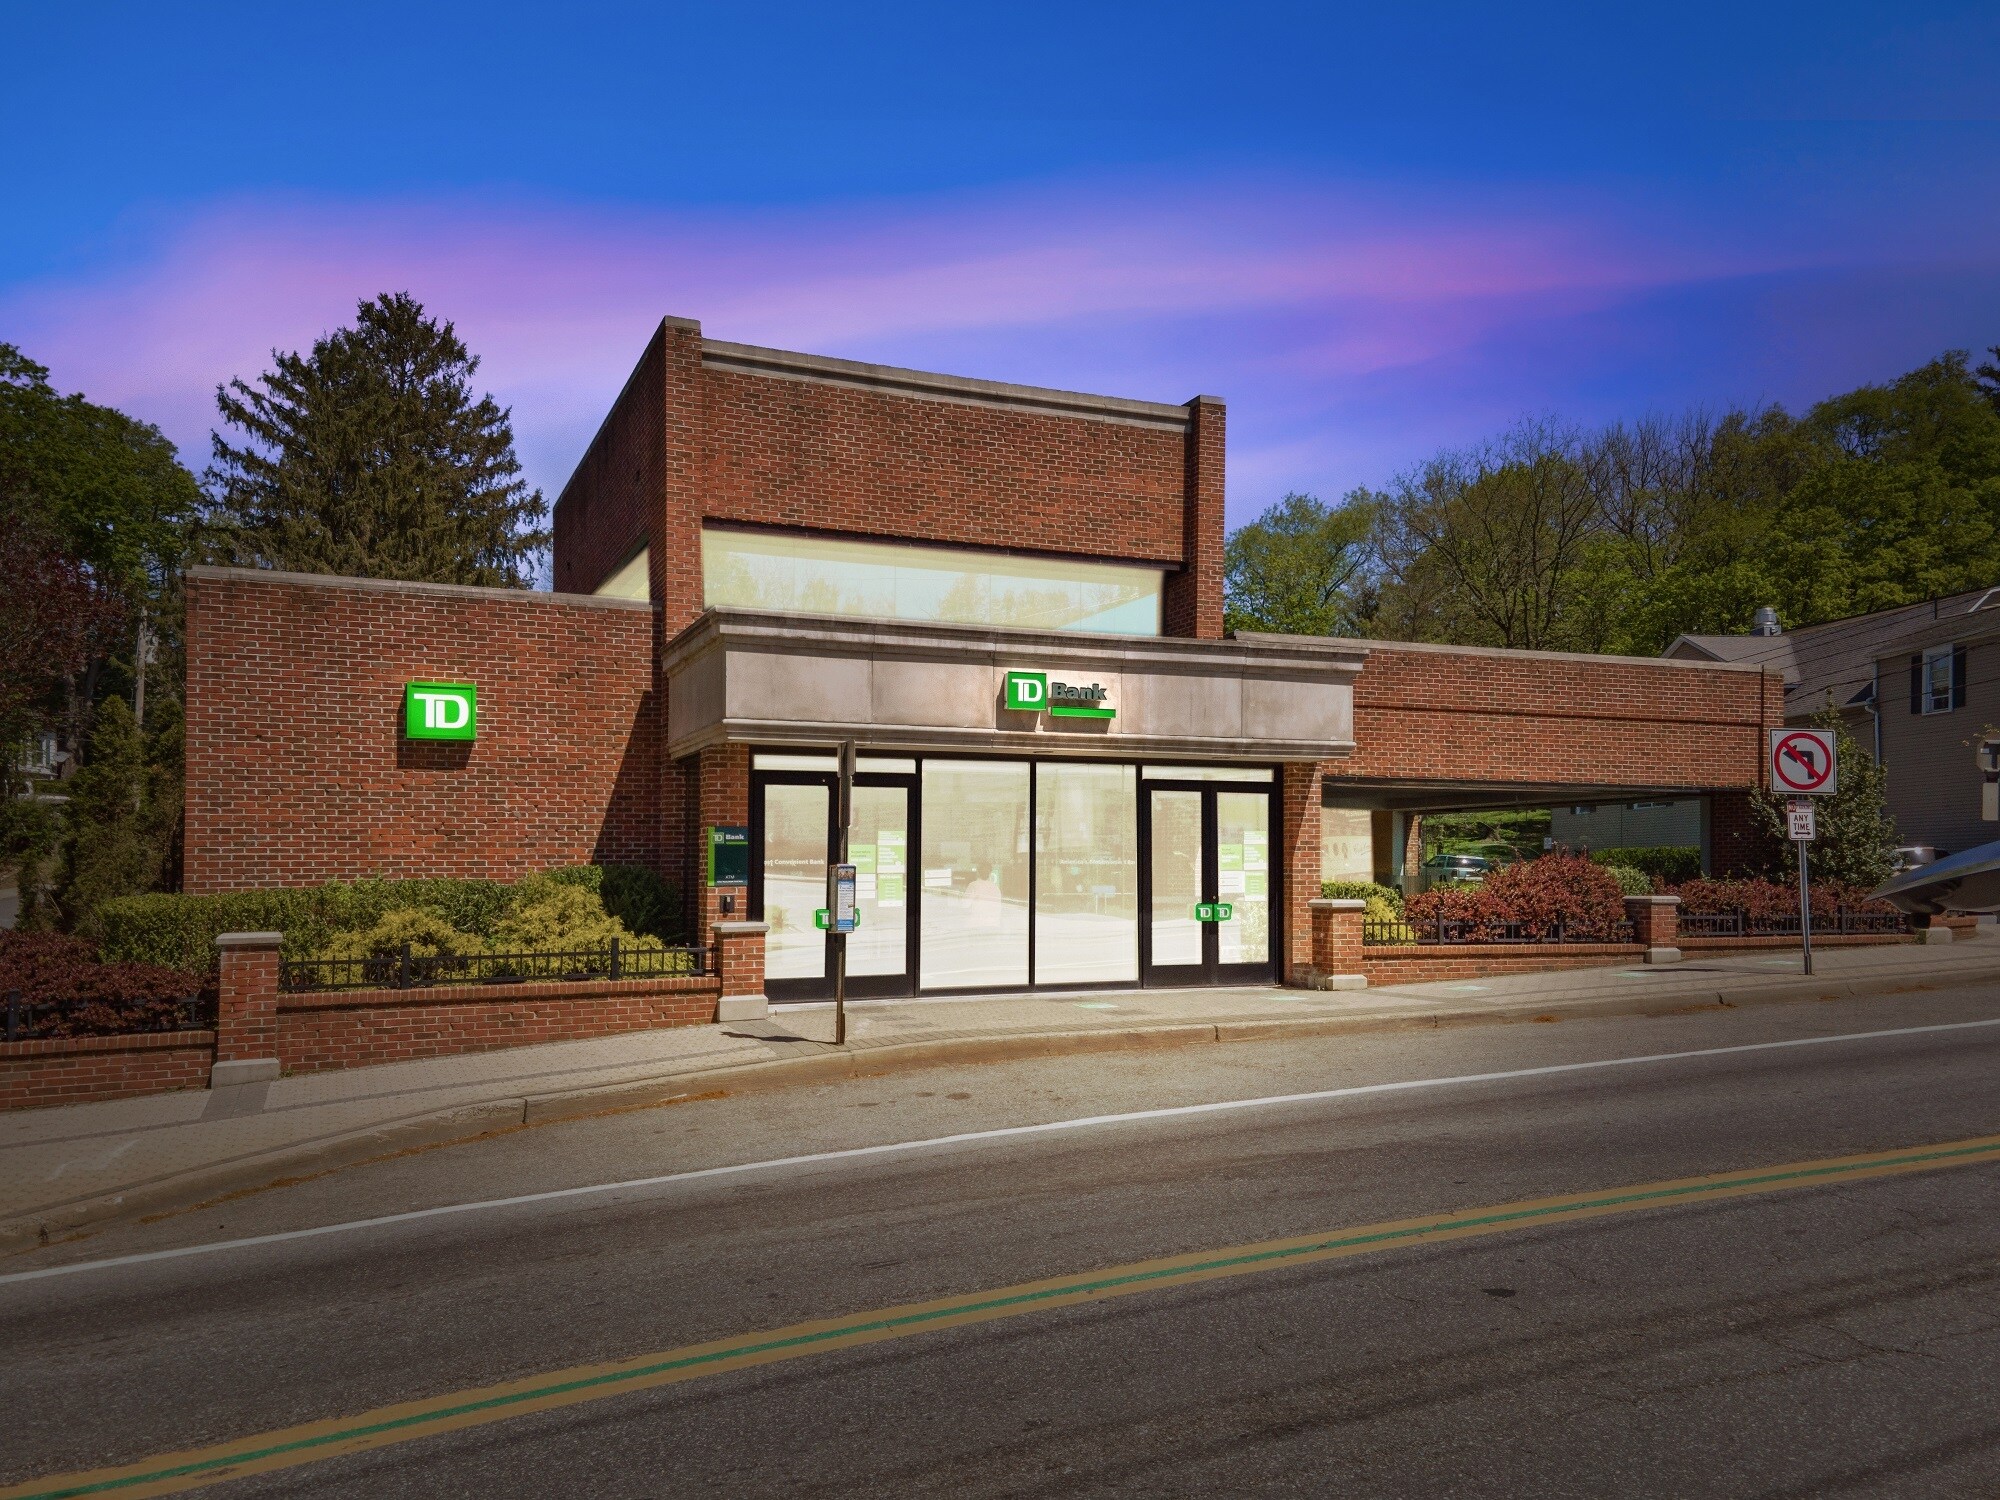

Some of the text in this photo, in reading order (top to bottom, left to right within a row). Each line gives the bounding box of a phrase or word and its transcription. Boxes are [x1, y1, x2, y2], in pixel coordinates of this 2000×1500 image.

[1011, 678, 1108, 702] TD Bank
[413, 693, 470, 729] TD
[1793, 814, 1808, 822] ANY
[1793, 823, 1810, 831] TIME
[713, 834, 723, 842] TD
[1198, 907, 1211, 919] TD
[1216, 907, 1230, 919] TD
